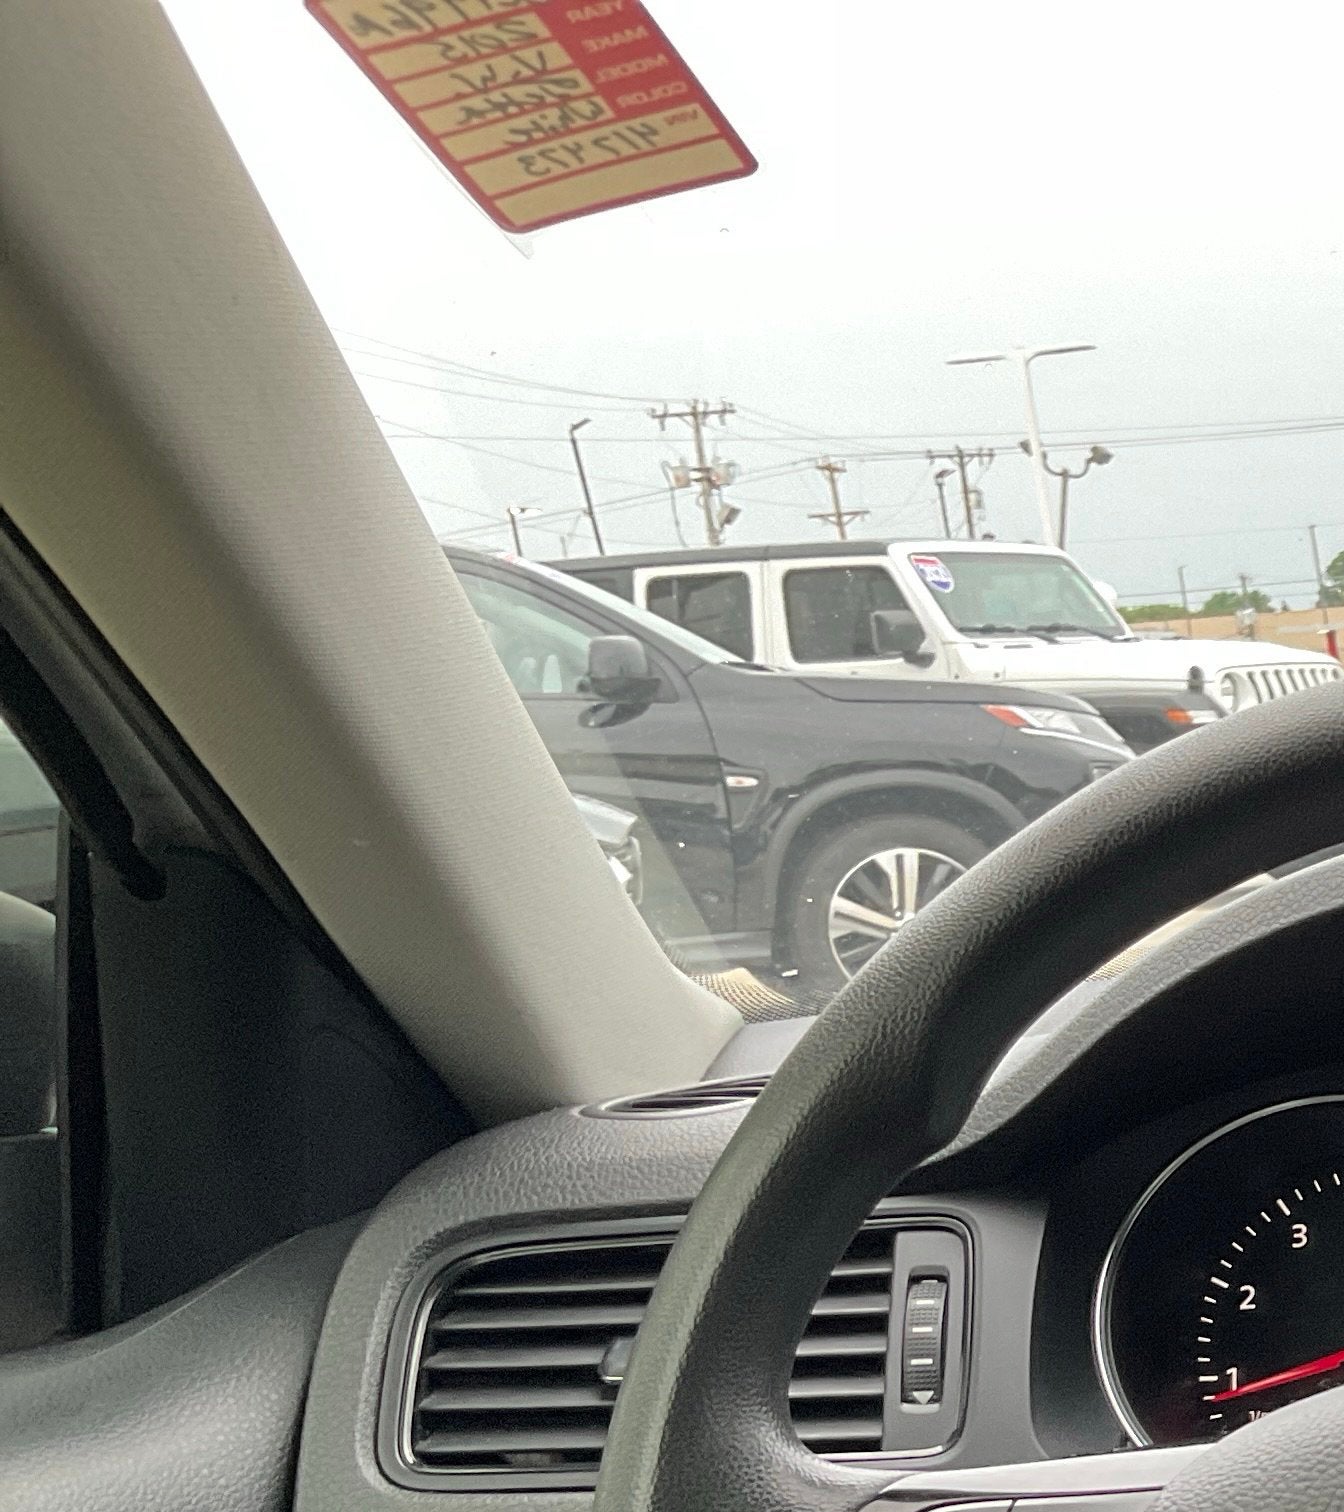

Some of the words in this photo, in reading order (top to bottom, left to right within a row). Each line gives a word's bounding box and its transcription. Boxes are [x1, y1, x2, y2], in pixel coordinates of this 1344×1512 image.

[1291, 1223, 1308, 1248] 3
[1239, 1285, 1256, 1311] 2
[1225, 1366, 1239, 1391] 1
